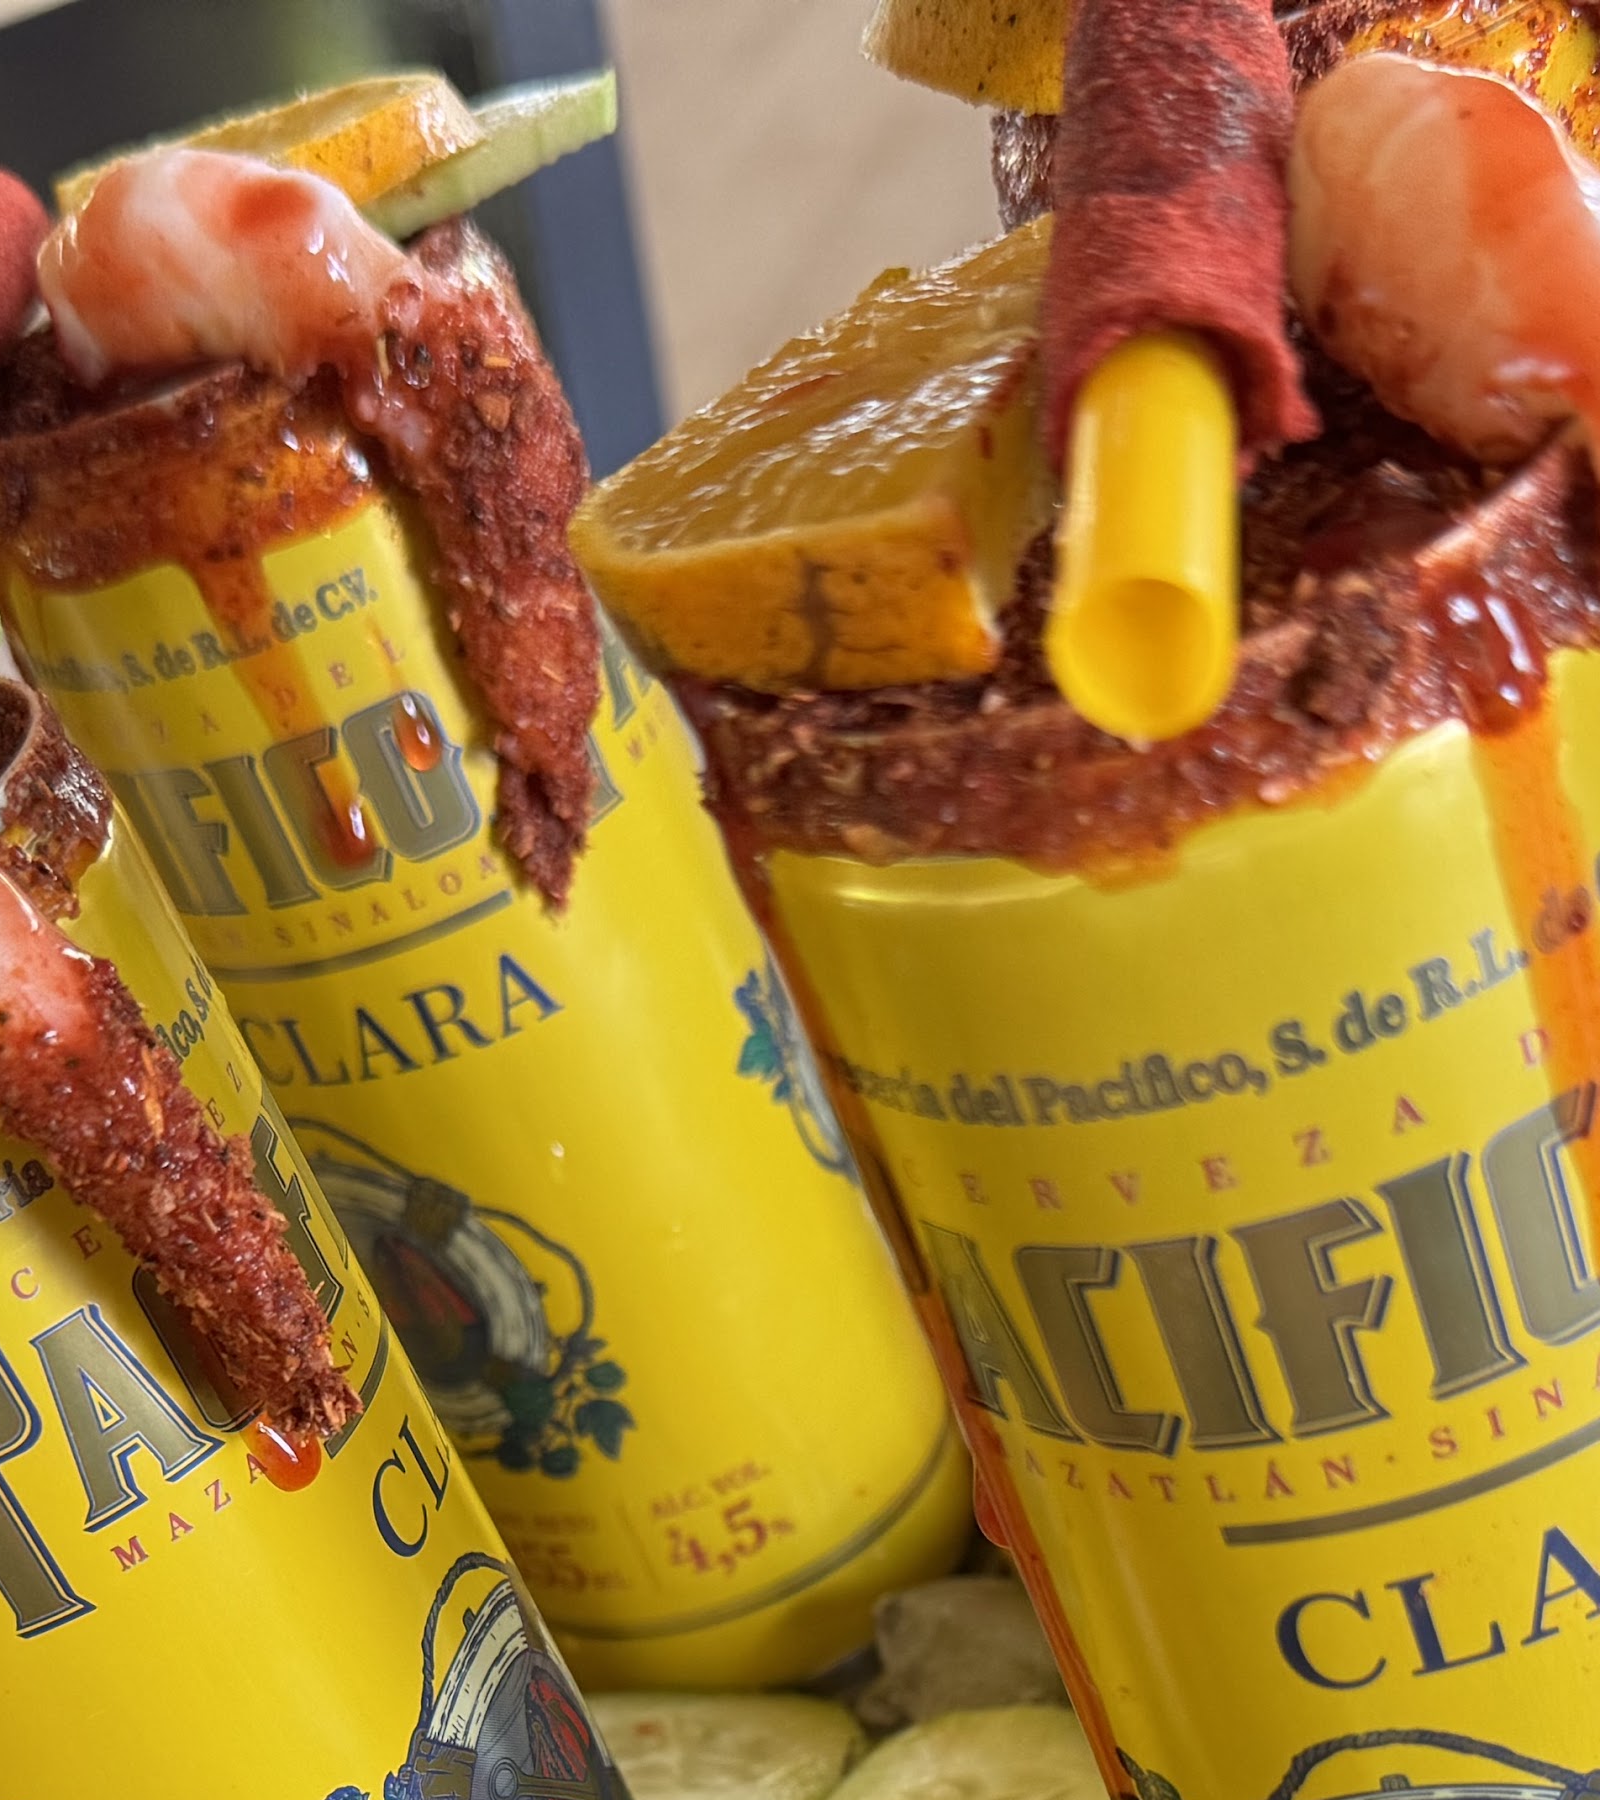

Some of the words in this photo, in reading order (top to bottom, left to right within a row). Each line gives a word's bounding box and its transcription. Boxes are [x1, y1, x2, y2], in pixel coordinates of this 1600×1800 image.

[272, 601, 317, 643] de
[315, 568, 378, 621] C.V.
[273, 852, 500, 949] SINALOA
[238, 949, 565, 1088] CLARA
[951, 1072, 1027, 1127] del
[1271, 1018, 1327, 1077] S.
[1333, 988, 1408, 1055] de
[1408, 927, 1532, 1022] R.L.
[1532, 884, 1593, 955] de
[1022, 1450, 1360, 1504] AZATLÁN
